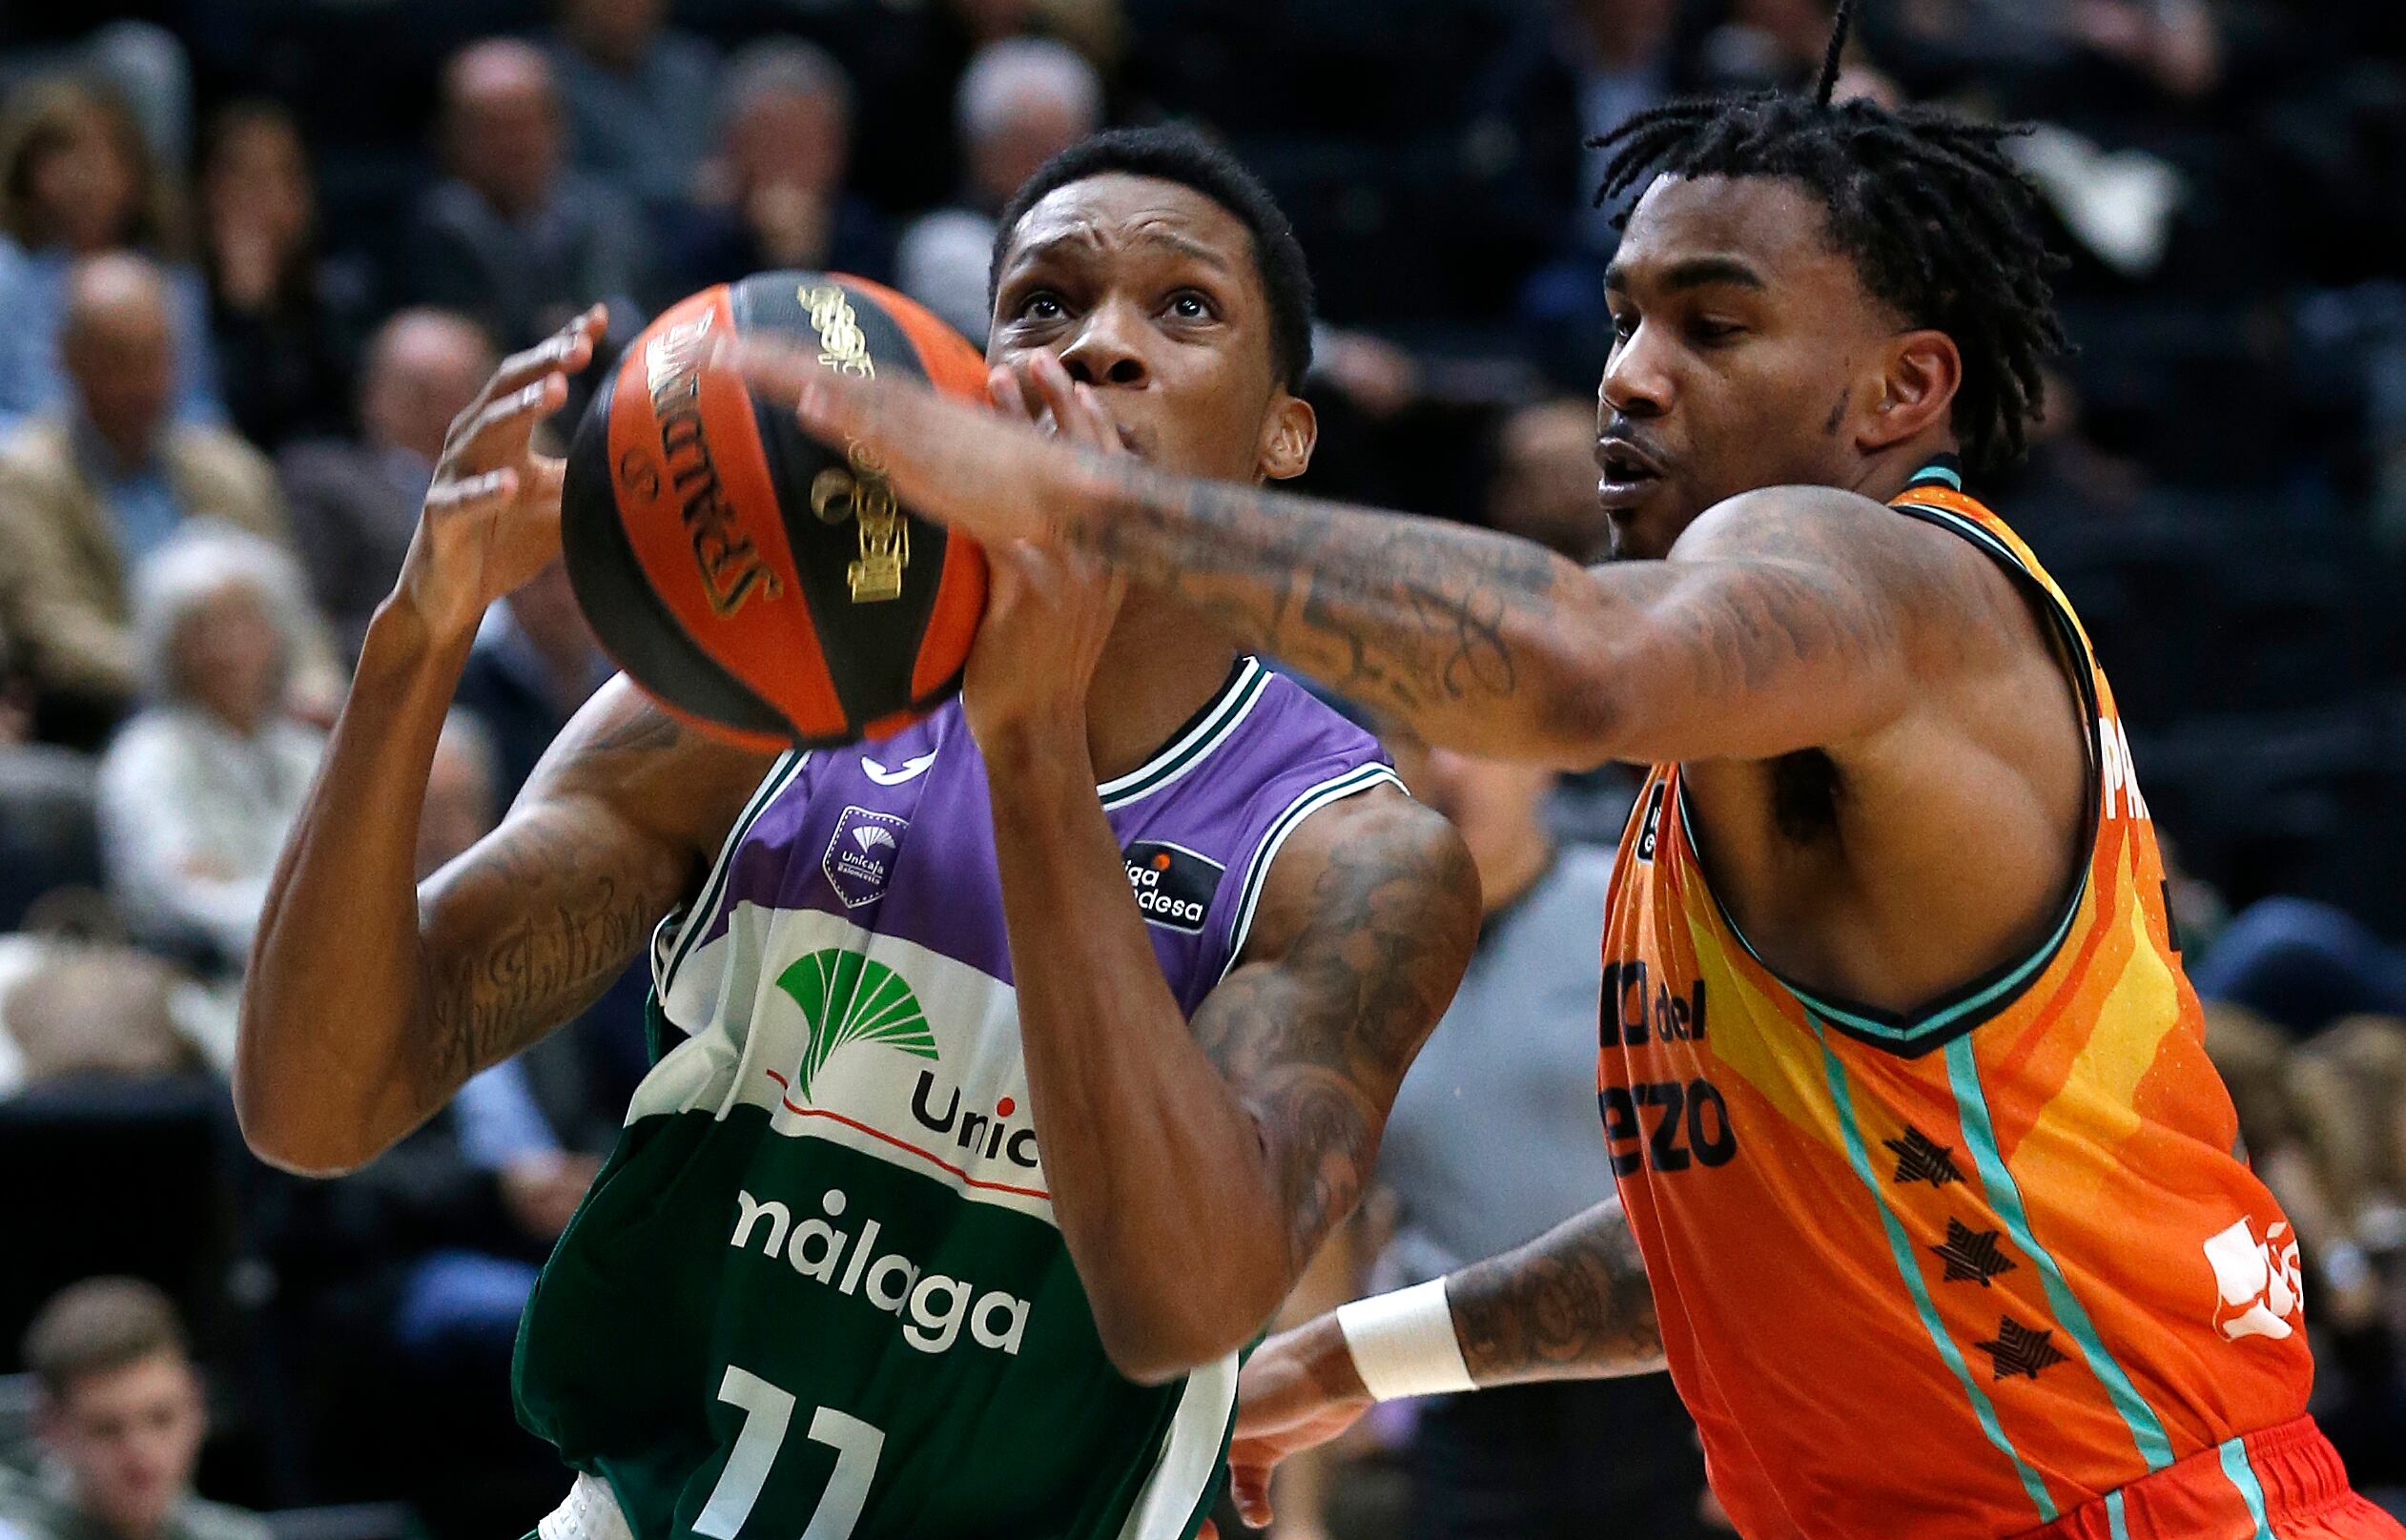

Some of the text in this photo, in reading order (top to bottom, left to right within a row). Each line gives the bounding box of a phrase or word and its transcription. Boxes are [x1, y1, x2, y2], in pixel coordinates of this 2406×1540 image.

[646, 303, 785, 619] SPALD
[842, 851, 884, 874] Unicaja
[1133, 888, 1203, 922] desa
[912, 1069, 1040, 1169] Unic
